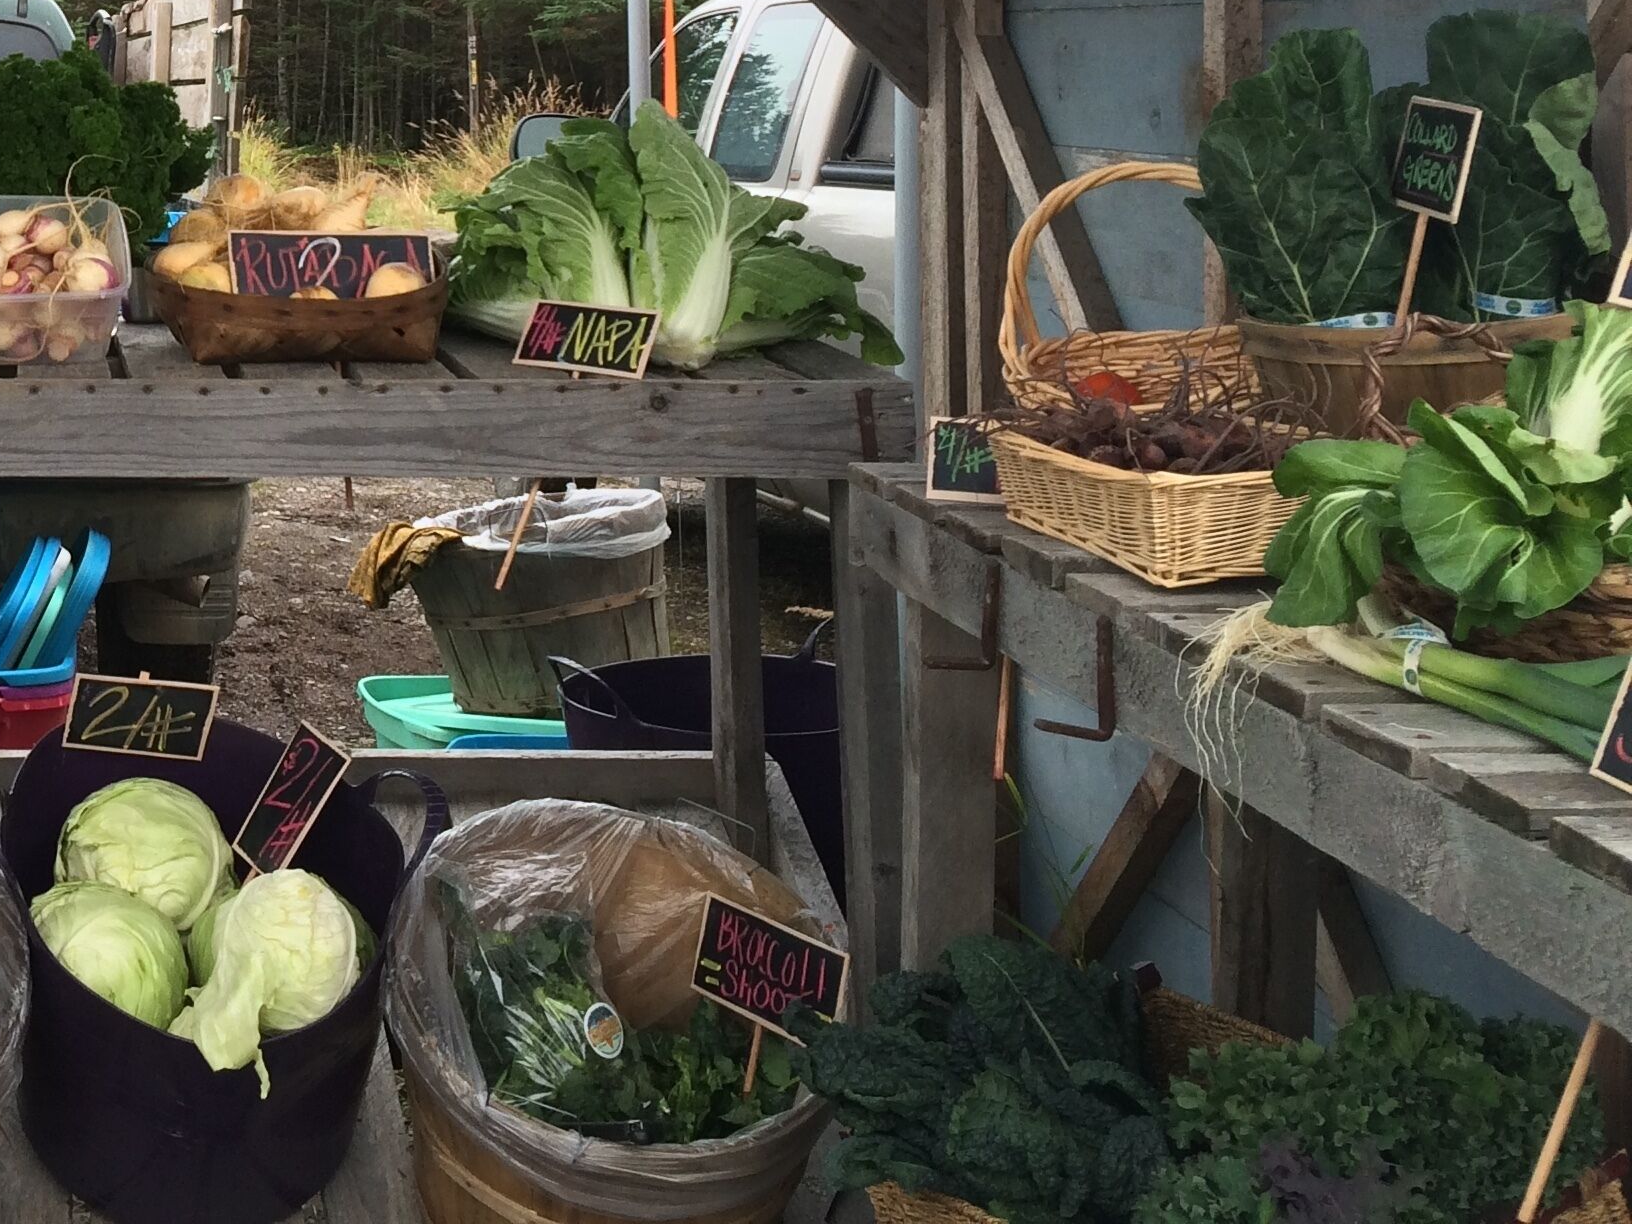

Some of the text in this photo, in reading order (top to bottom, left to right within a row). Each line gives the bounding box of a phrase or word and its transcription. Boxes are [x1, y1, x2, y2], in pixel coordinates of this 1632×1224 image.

[1408, 112, 1458, 154] COLLARD
[1403, 155, 1457, 201] GREENS
[557, 311, 649, 369] NAPA
